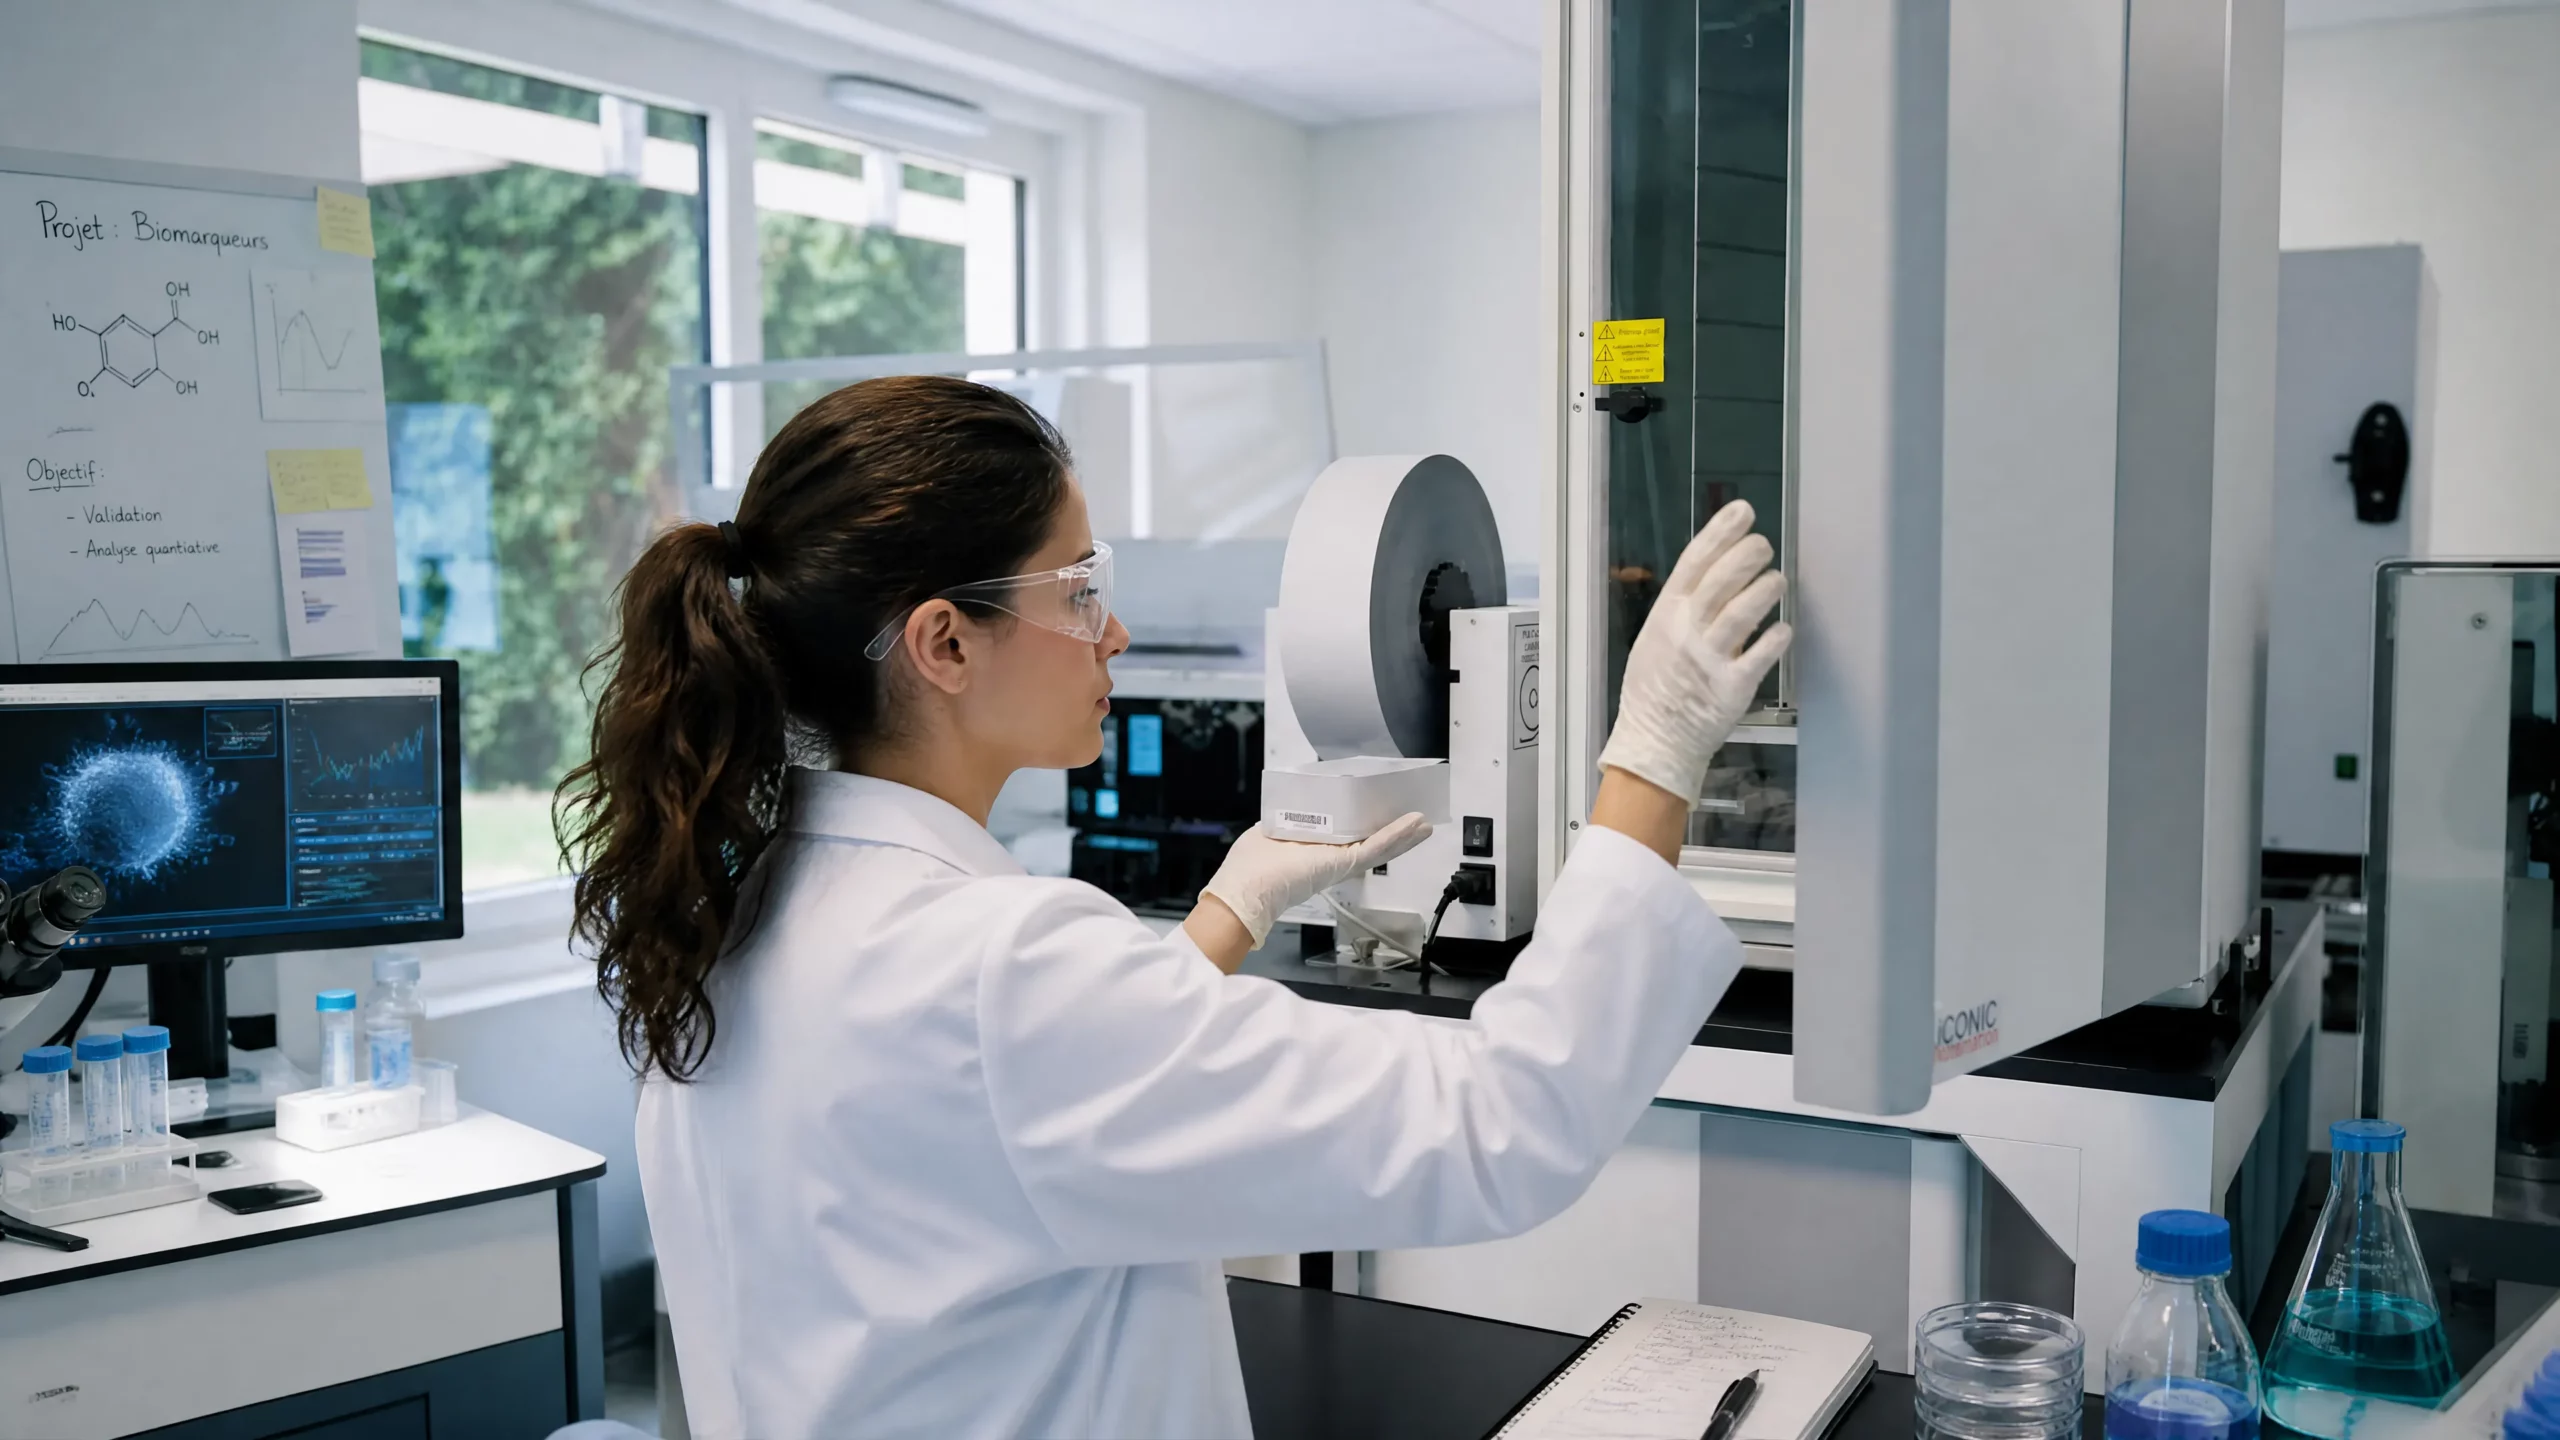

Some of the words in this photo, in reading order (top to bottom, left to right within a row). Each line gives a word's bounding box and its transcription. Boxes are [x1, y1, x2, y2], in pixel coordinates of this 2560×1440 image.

[36, 200, 104, 251] Projet
[131, 210, 269, 257] Biomarqueurs
[165, 281, 191, 297] OH
[52, 313, 77, 331] HO
[197, 330, 220, 345] OH
[175, 380, 198, 395] OH
[82, 503, 163, 525] Validation
[86, 538, 138, 564] Analyse
[145, 540, 220, 565] quantiative
